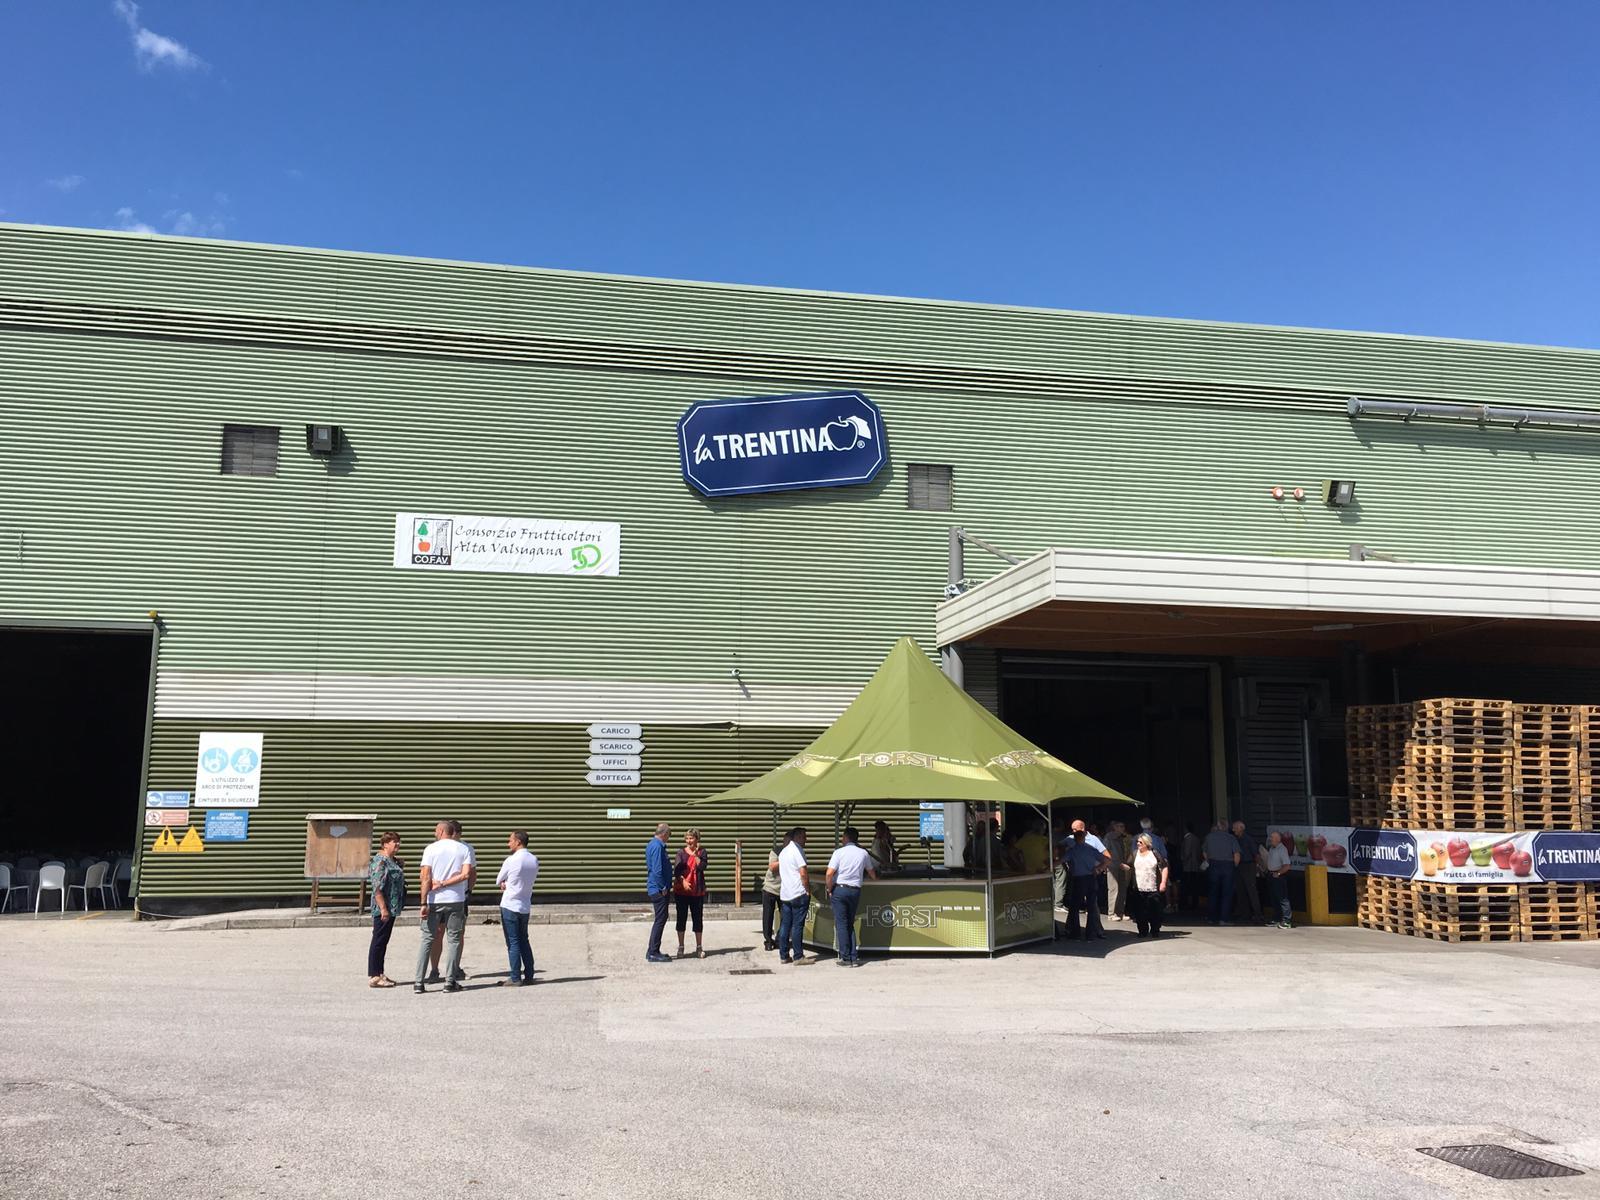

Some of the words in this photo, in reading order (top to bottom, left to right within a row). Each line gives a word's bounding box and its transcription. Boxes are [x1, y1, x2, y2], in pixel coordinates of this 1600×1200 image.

[693, 434, 715, 464] la
[713, 427, 835, 460] TRENTINA
[455, 525, 517, 539] Consorzio
[520, 528, 602, 542] Frutticoltori
[454, 541, 486, 553] Alta
[491, 542, 563, 562] Valsugana
[858, 750, 938, 769] FORST
[1360, 845, 1400, 861] TRENTINA
[1546, 849, 1600, 864] TRENTINA
[1475, 871, 1504, 879] famiglia
[866, 904, 942, 928] FORST
